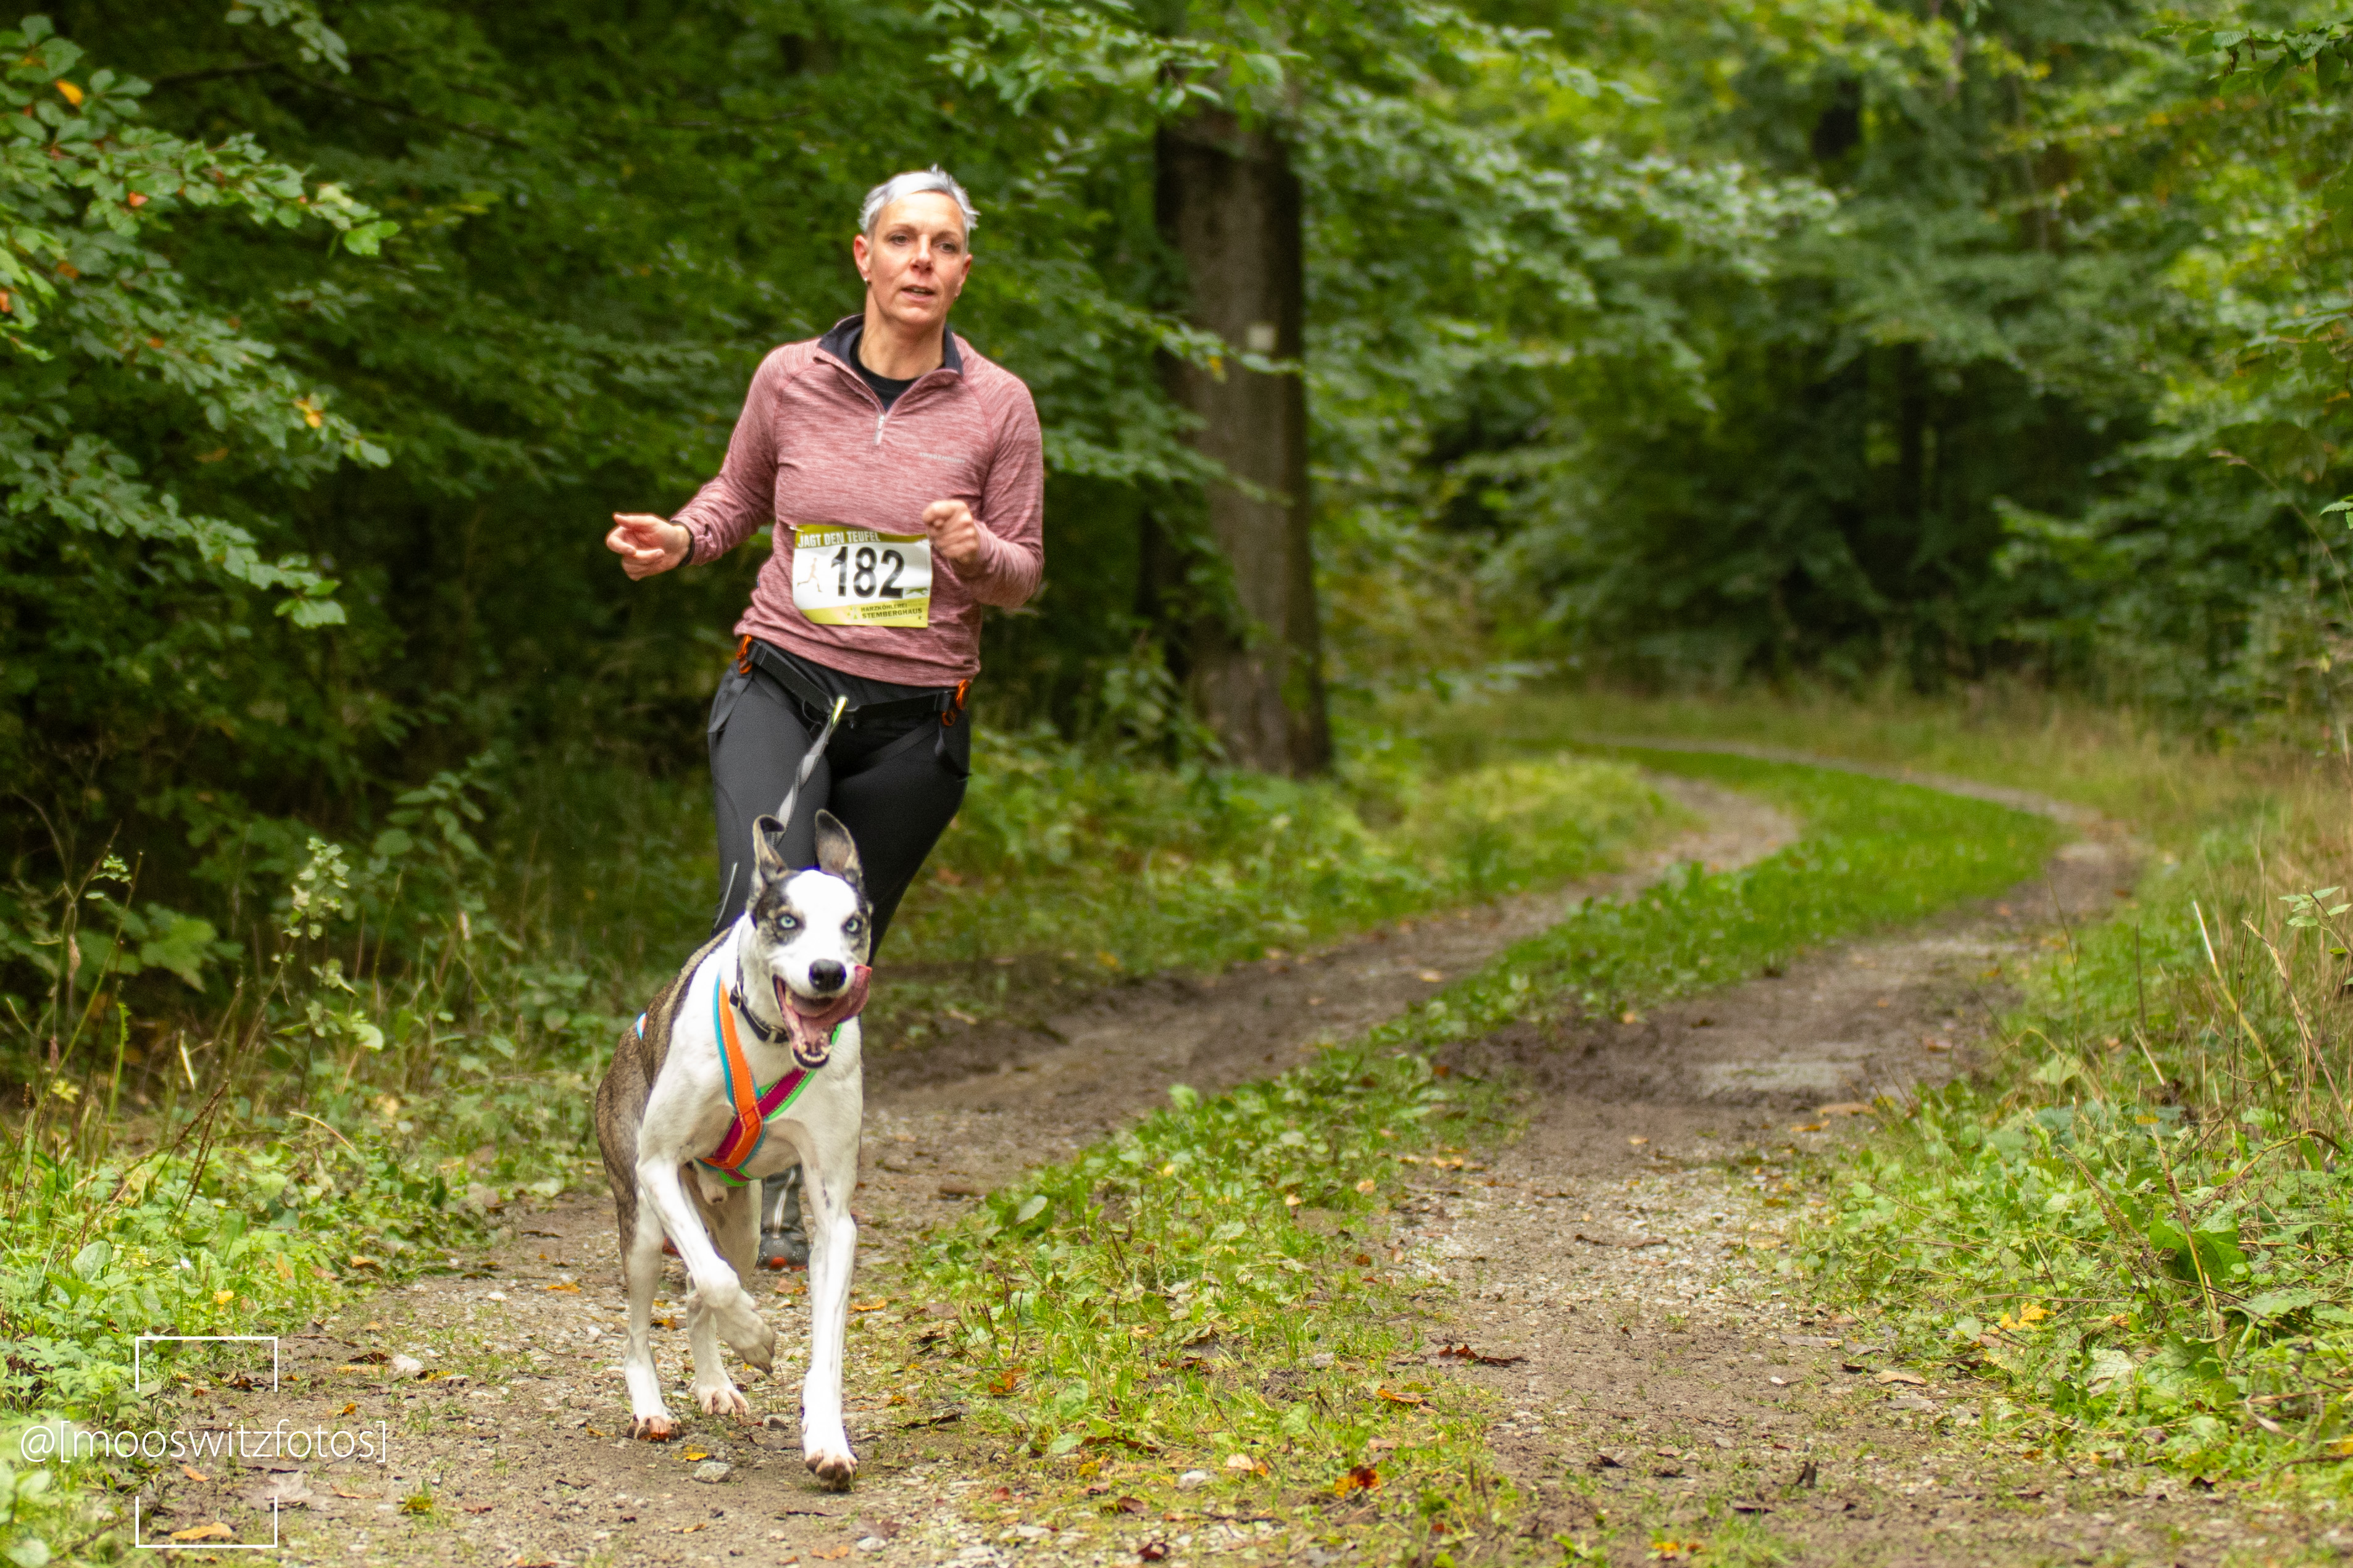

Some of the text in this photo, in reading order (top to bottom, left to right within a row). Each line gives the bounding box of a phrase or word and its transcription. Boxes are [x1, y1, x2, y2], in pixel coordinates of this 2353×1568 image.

[798, 531, 880, 547] JAGT DEN TEUFEL
[831, 546, 904, 599] 182
[862, 608, 922, 619] STEMBERGHAUS
